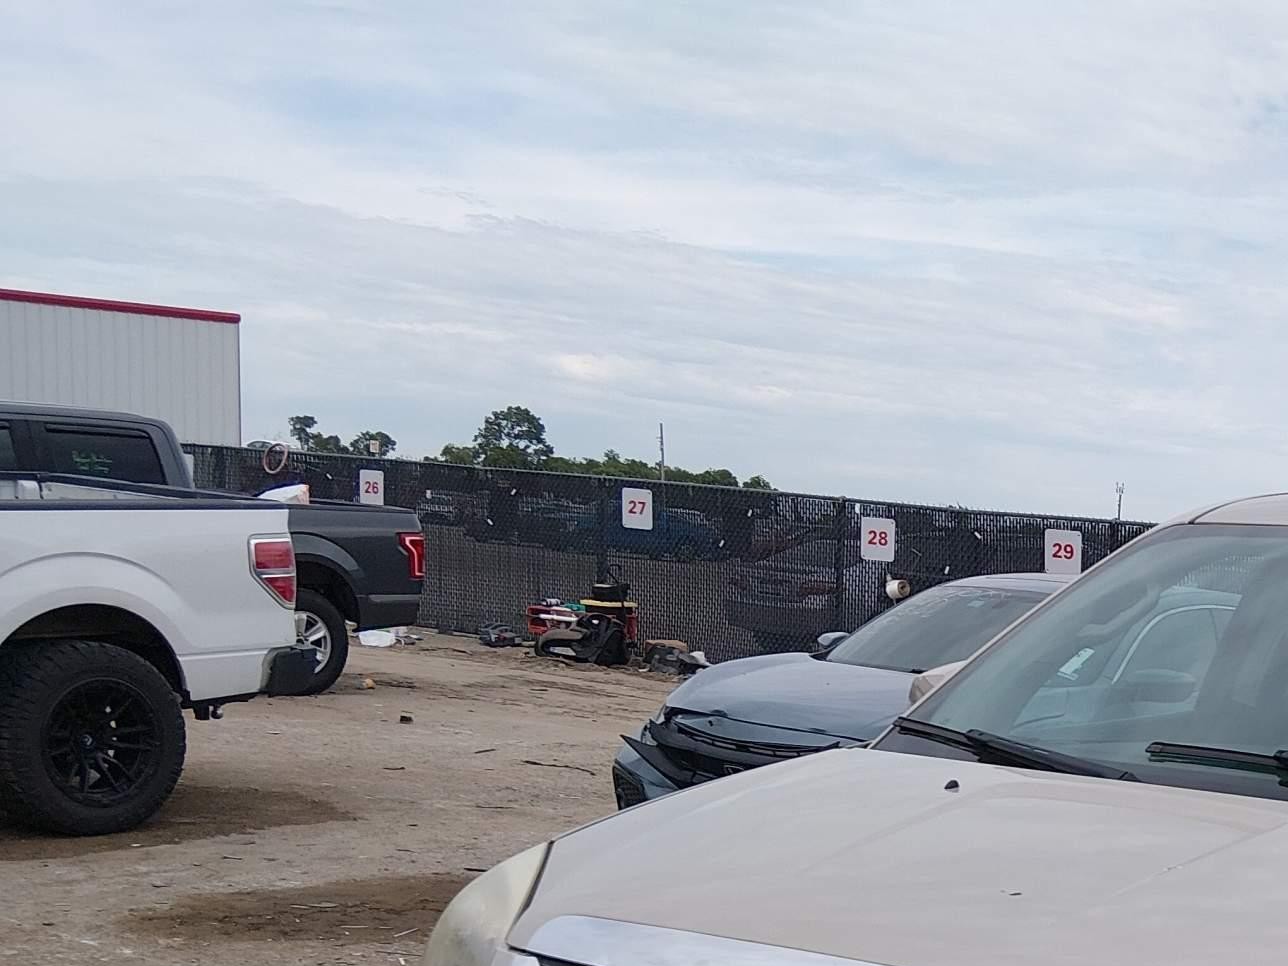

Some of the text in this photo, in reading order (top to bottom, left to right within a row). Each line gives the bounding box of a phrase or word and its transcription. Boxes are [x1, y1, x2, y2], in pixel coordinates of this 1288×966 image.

[364, 480, 379, 495] 26
[628, 500, 646, 515] 27
[867, 530, 888, 546] 28
[1052, 542, 1074, 560] 29
